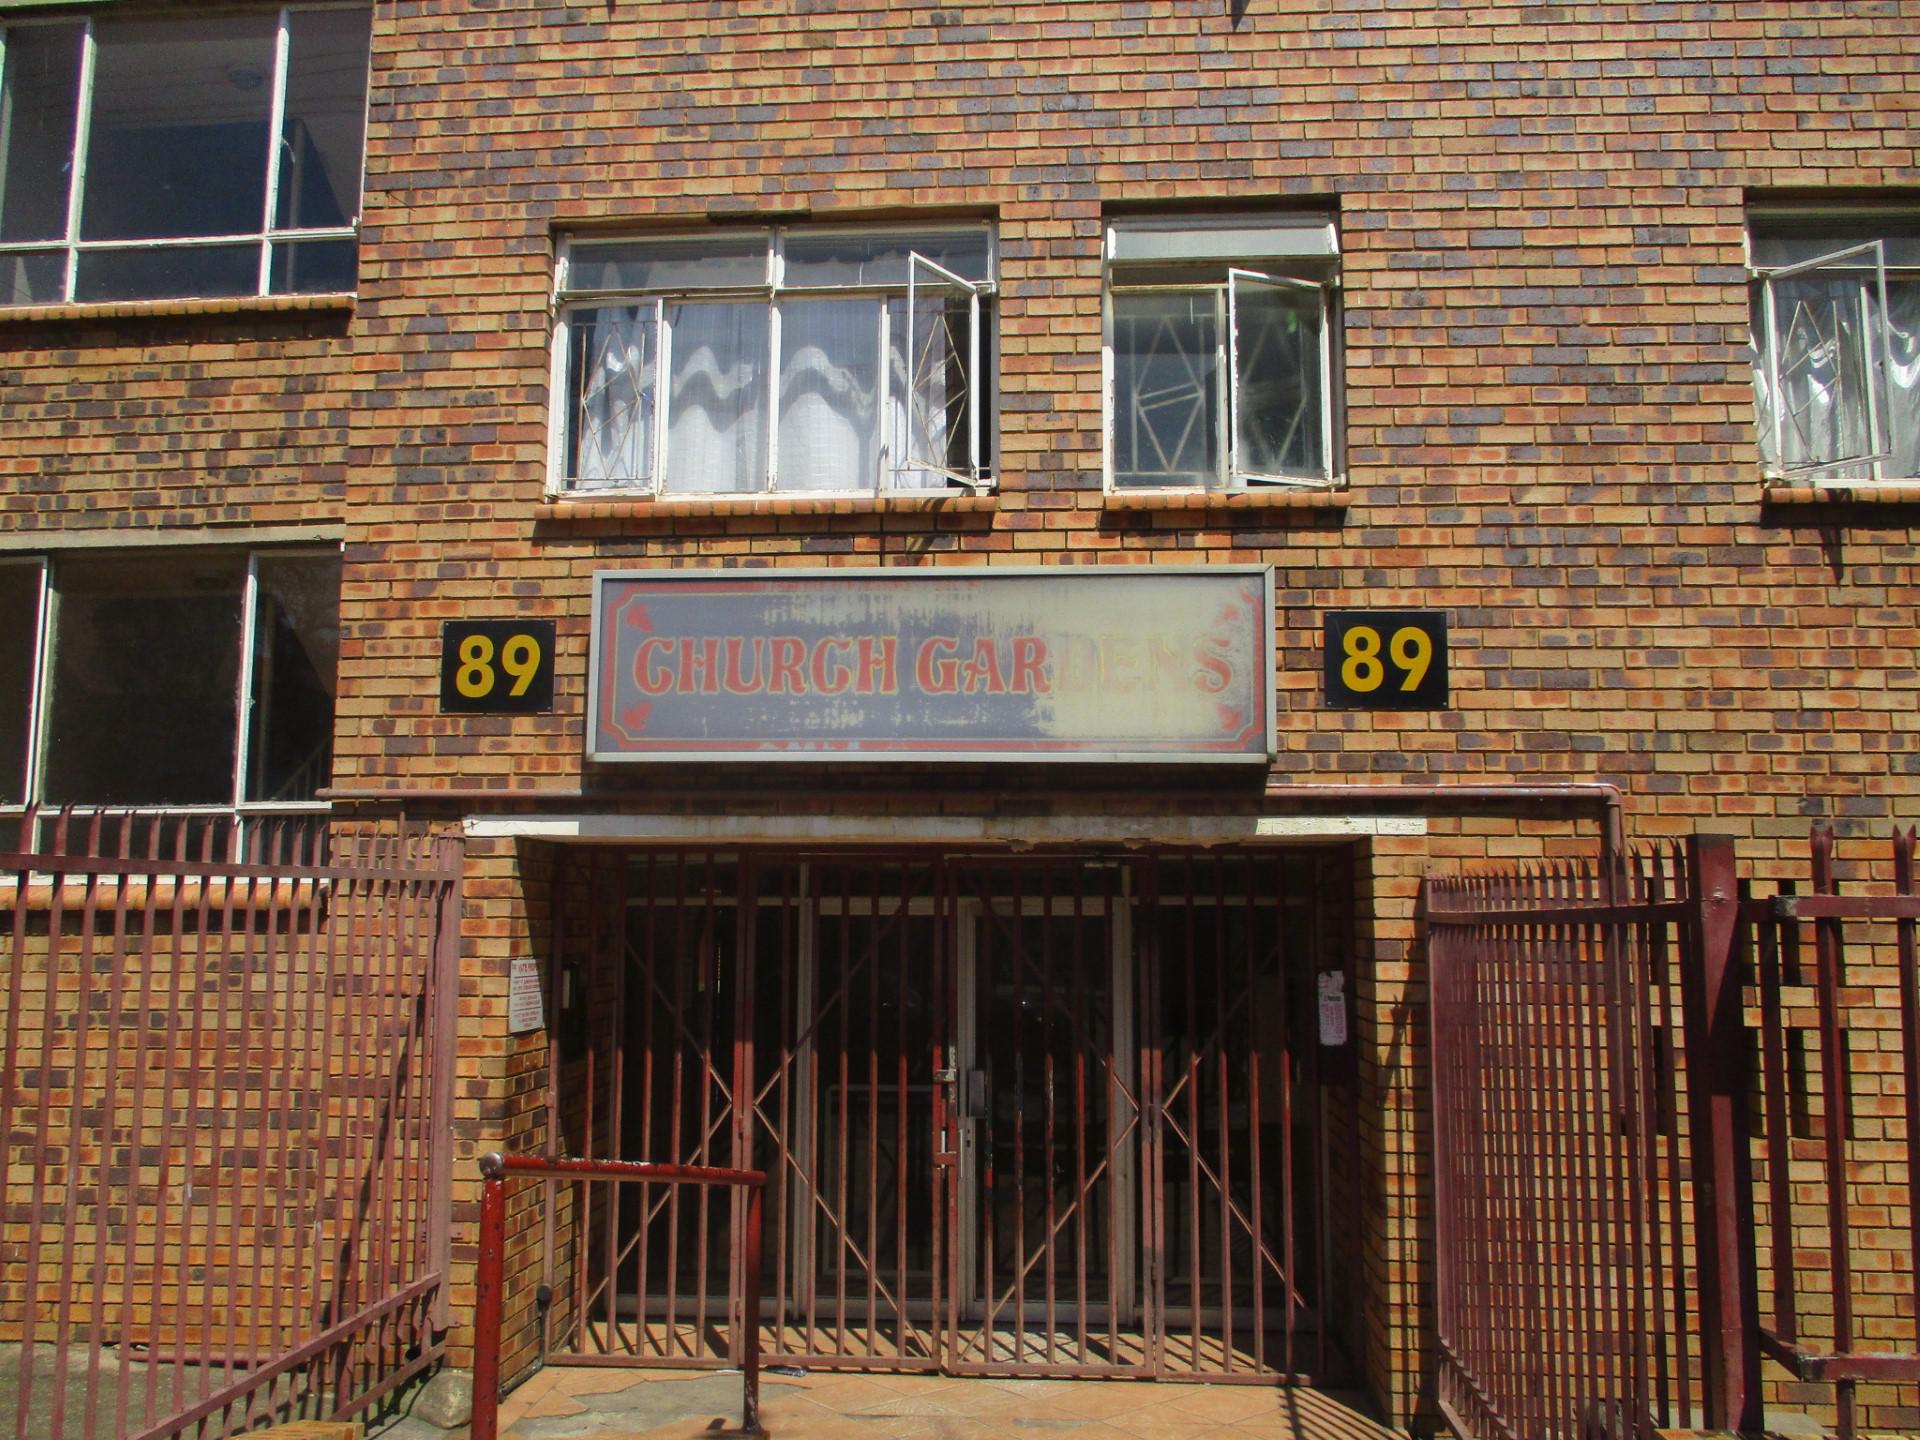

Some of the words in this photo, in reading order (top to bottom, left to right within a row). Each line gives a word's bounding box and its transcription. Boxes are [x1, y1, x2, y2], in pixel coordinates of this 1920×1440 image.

[456, 634, 541, 698] 89
[632, 635, 898, 696] CHURCH
[1341, 626, 1432, 693] 89
